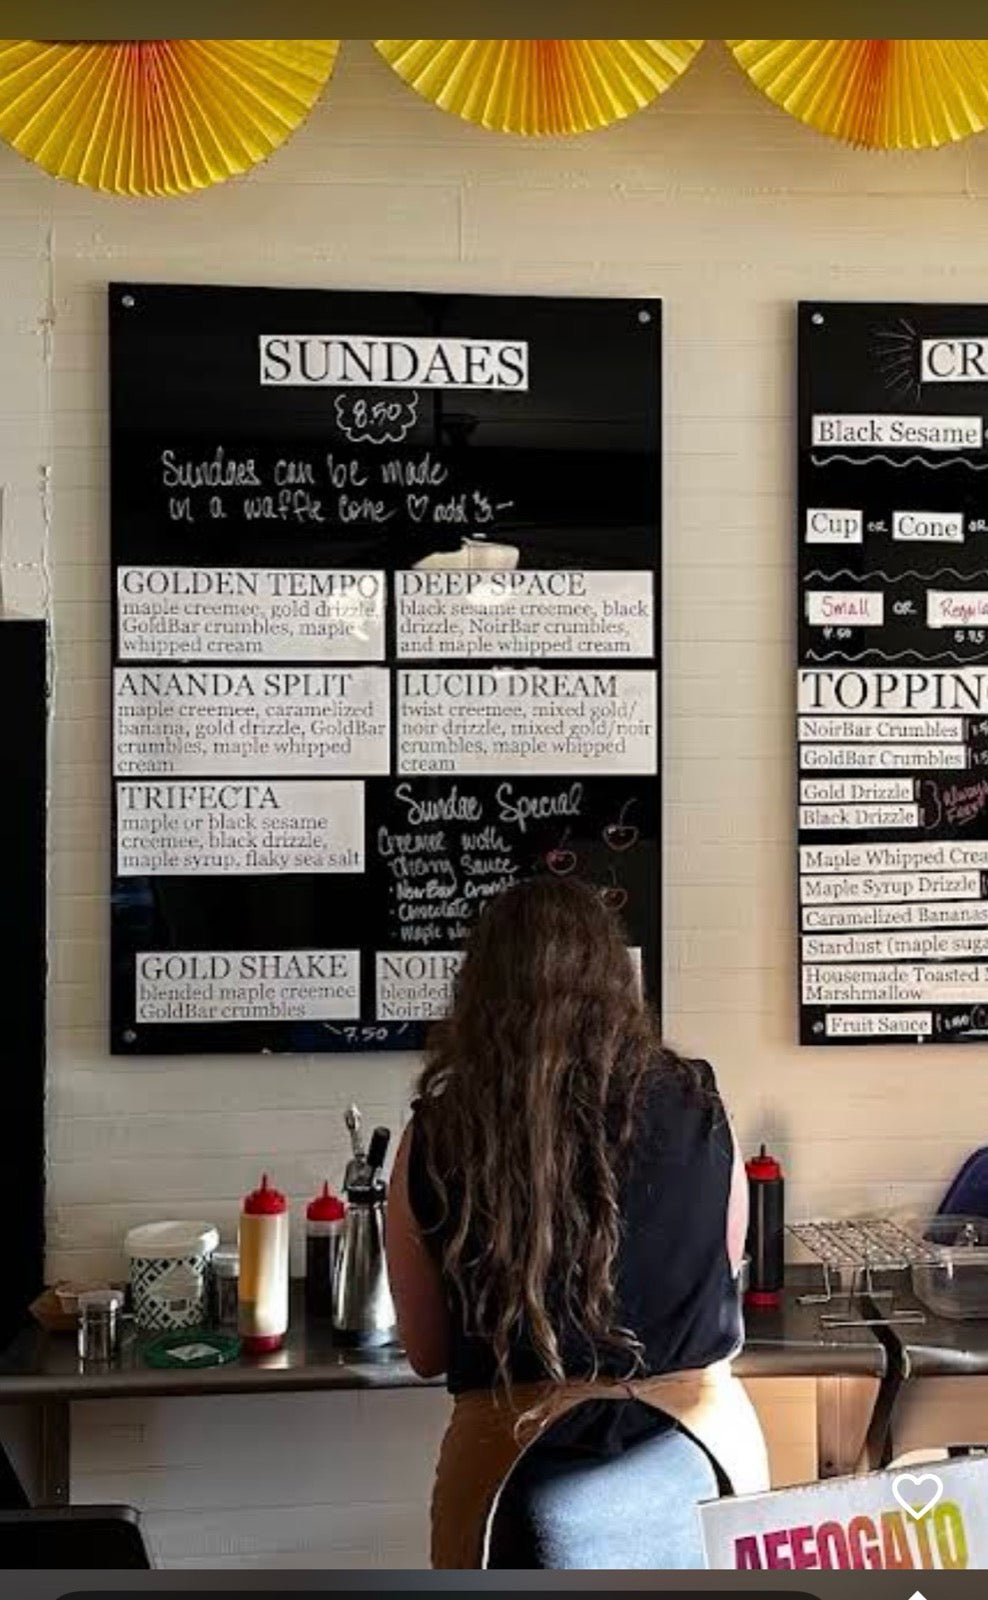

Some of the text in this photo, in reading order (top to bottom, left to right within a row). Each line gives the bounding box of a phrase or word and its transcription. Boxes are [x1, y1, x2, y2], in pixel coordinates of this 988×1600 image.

[264, 339, 524, 387] SUNDAES
[818, 420, 883, 442] Black
[890, 420, 977, 444] Sesame
[161, 446, 448, 488] Sundaes can be made
[169, 496, 195, 522] in
[210, 496, 228, 519] a
[243, 489, 325, 522] waffle
[434, 494, 468, 523] add
[811, 512, 859, 539] Cup
[898, 515, 959, 537] Cone
[122, 570, 379, 599] GOLDEN TEMPO
[401, 572, 588, 597] DEEP SPACE
[123, 600, 179, 619] maple
[184, 602, 261, 618] creemee,
[271, 601, 311, 620] gold
[400, 600, 650, 618] black sesame creemee, black
[820, 595, 870, 619] Small
[122, 617, 354, 639] GoldBar crumbles, maple
[400, 618, 631, 637] drizzle, NoirBar crumbles,
[123, 636, 262, 656] whipped cream
[400, 637, 631, 657] and maple whipped cream
[117, 672, 352, 698] ANANDA SPLIT
[403, 673, 618, 699] LUCID DREAM
[802, 672, 988, 710] TOPPIN
[117, 700, 374, 721] maple creemee, caramelized
[401, 701, 638, 722] twist creemee, mixed gold/
[118, 718, 387, 740] banana, gold drizzle, GoldBar
[401, 719, 653, 740] noir drizzle, mixed gold/noir
[802, 720, 873, 738] NoirBar
[876, 719, 959, 738] Crumbles
[117, 736, 352, 758] crumbles, maple whipped
[400, 737, 627, 759] crumbles, maple whipped
[803, 749, 876, 766] GoldBar
[879, 748, 963, 766] Crumbles
[117, 757, 174, 773] cream
[400, 757, 456, 773] cream
[121, 785, 281, 811] TRIFECTA
[803, 782, 910, 800] Gold Drizzle
[495, 781, 584, 834] Special
[803, 806, 915, 825] Black Drizzle
[121, 811, 329, 835] maple or black sesame
[121, 830, 328, 851] creemee, black drizzle,
[122, 848, 360, 872] maple syrup, flaky sea salt
[460, 853, 519, 876] Sauce
[806, 851, 861, 871] Maple
[866, 848, 944, 869] Whipped
[805, 875, 977, 899] Maple Syrup Drizzle
[806, 906, 912, 927] Caramelized
[807, 936, 882, 956] Stardust
[887, 934, 949, 957] (maple
[140, 953, 348, 981] GOLD SHAKE
[381, 956, 461, 980] NOIR
[805, 966, 909, 983] Housemade
[912, 966, 979, 983] Toasted
[140, 982, 356, 1006] blended maple creemee
[380, 982, 450, 1001] blended
[805, 984, 923, 1001] Marshmallow
[139, 1000, 306, 1020] GoldBar crumbles
[381, 1001, 449, 1018] NoirBar
[830, 1014, 929, 1034] Fruit Sauce
